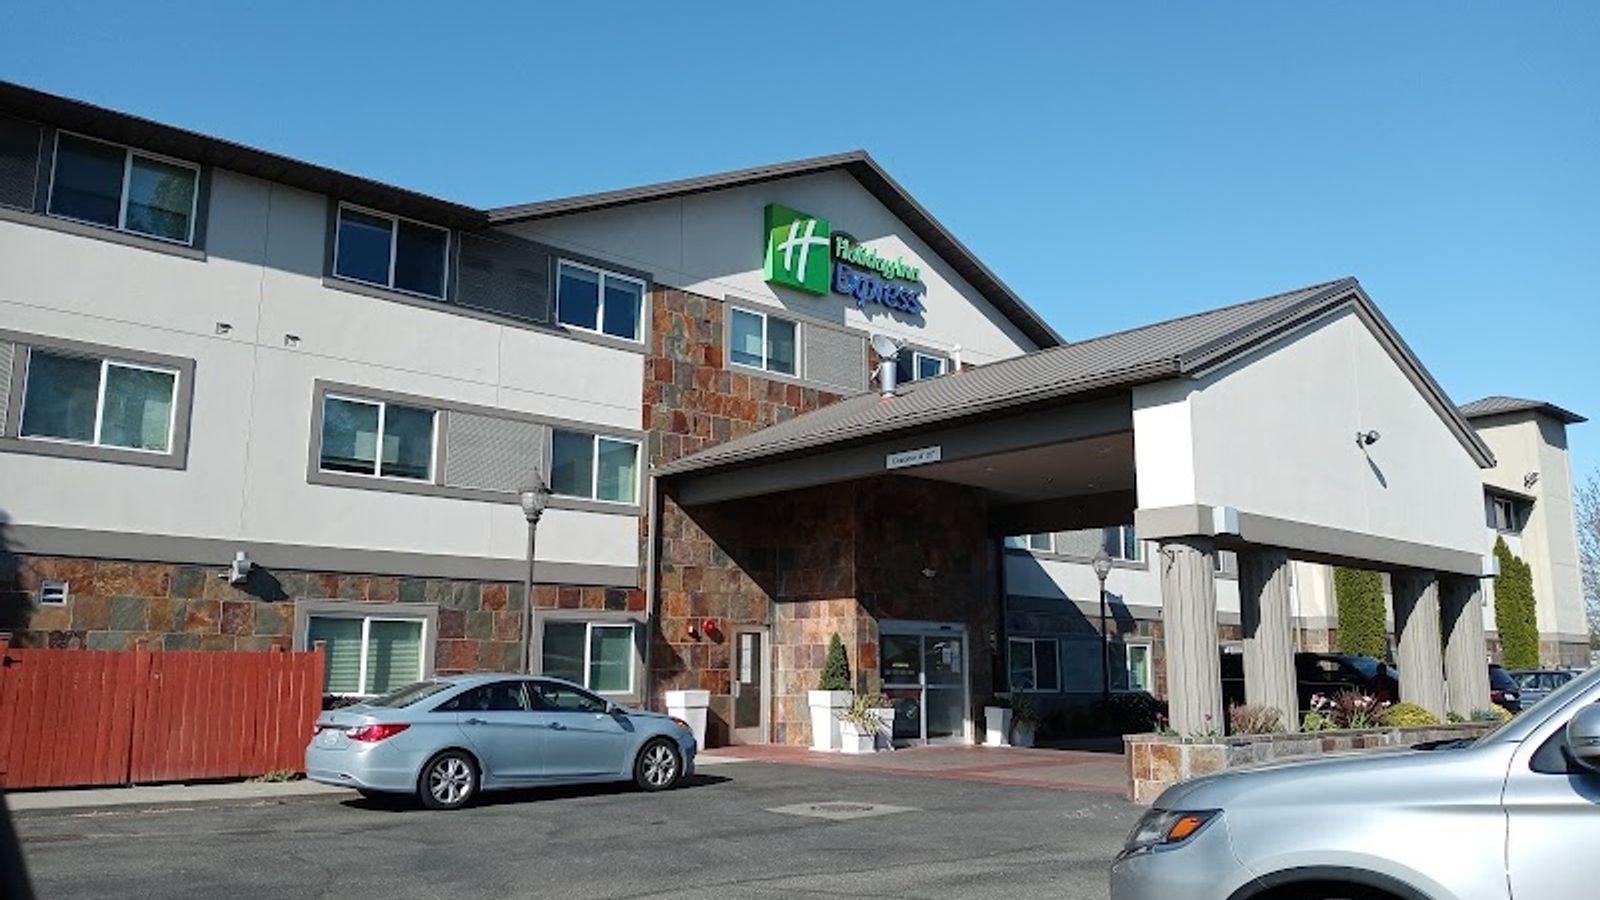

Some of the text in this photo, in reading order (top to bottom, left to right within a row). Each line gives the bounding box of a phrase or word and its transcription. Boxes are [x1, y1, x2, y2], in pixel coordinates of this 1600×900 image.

[835, 236, 920, 280] Holiday Inn
[835, 262, 922, 313] Express
